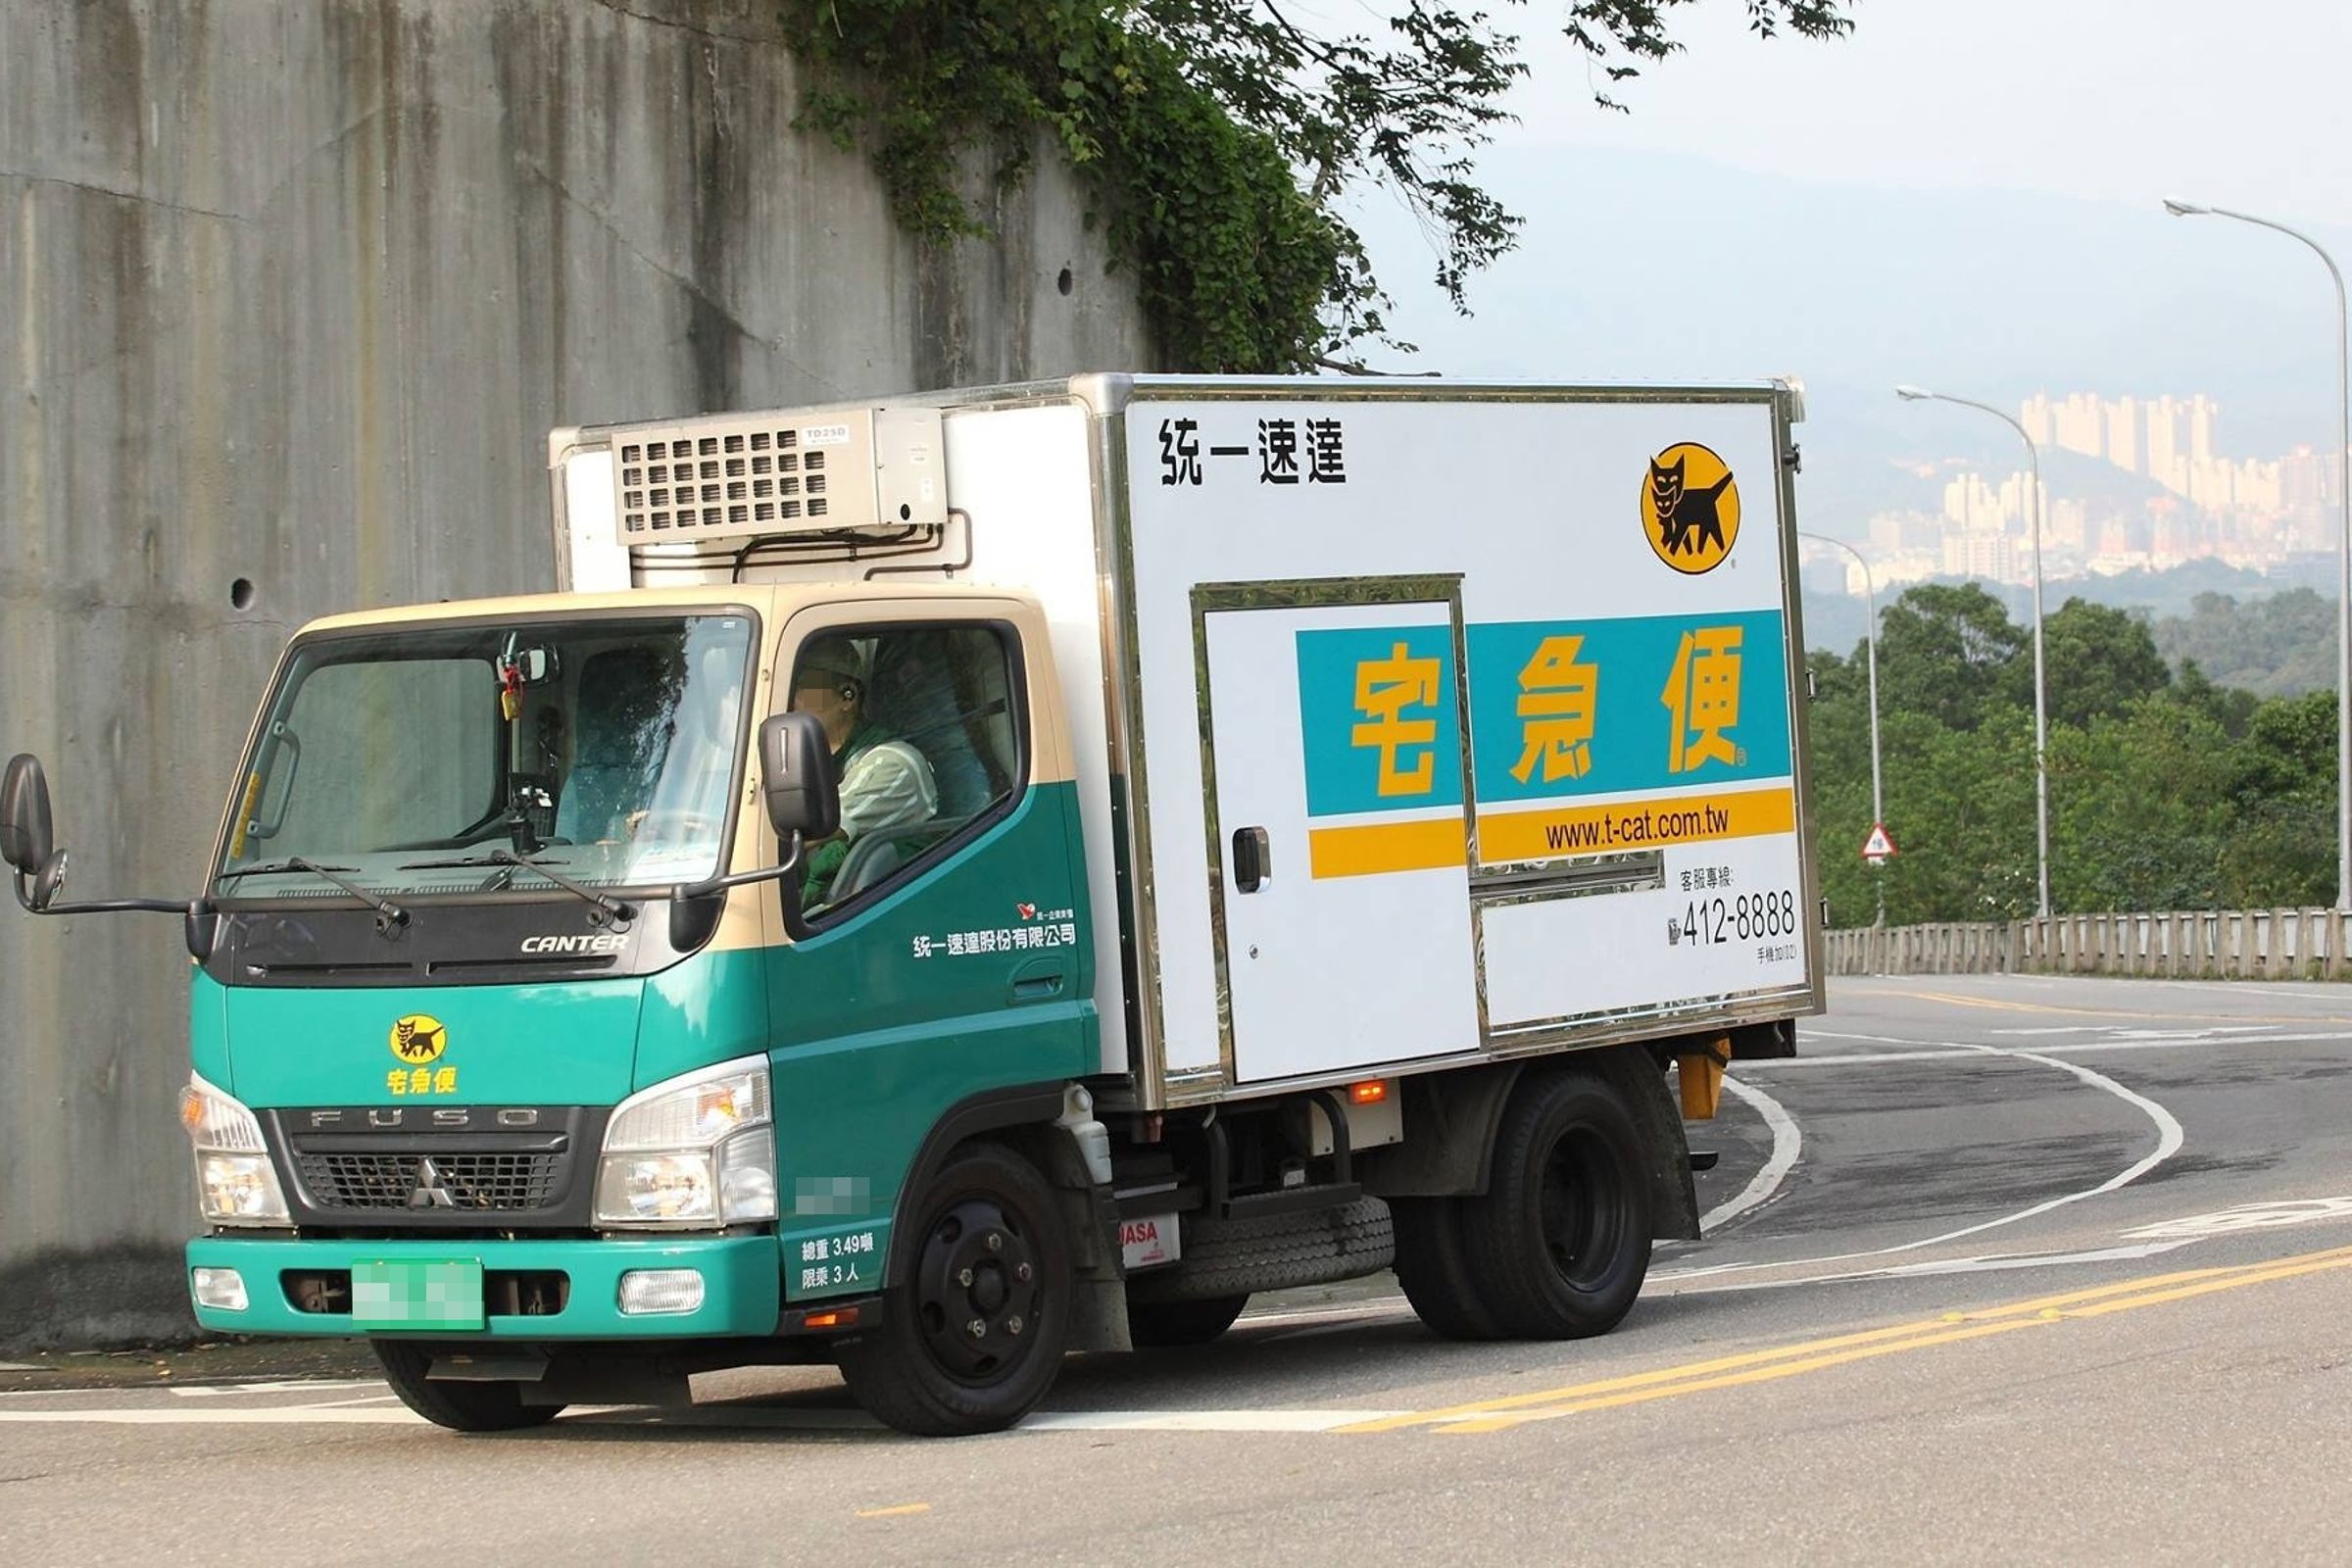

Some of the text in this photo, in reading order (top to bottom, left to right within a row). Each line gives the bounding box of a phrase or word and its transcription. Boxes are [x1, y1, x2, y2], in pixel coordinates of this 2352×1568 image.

[1159, 417, 1347, 486] 統一速達
[1350, 625, 1744, 798] 宅急便
[1545, 805, 1730, 851] www.t-cat.com.tw
[1683, 889, 1795, 947] 412-8888
[520, 935, 630, 954] CANTER
[912, 923, 1076, 958] 統一速達股份有限公司
[386, 1066, 458, 1097] 宅急便
[311, 1108, 539, 1127] FUSO
[802, 1262, 859, 1290] 限乘 3 人
